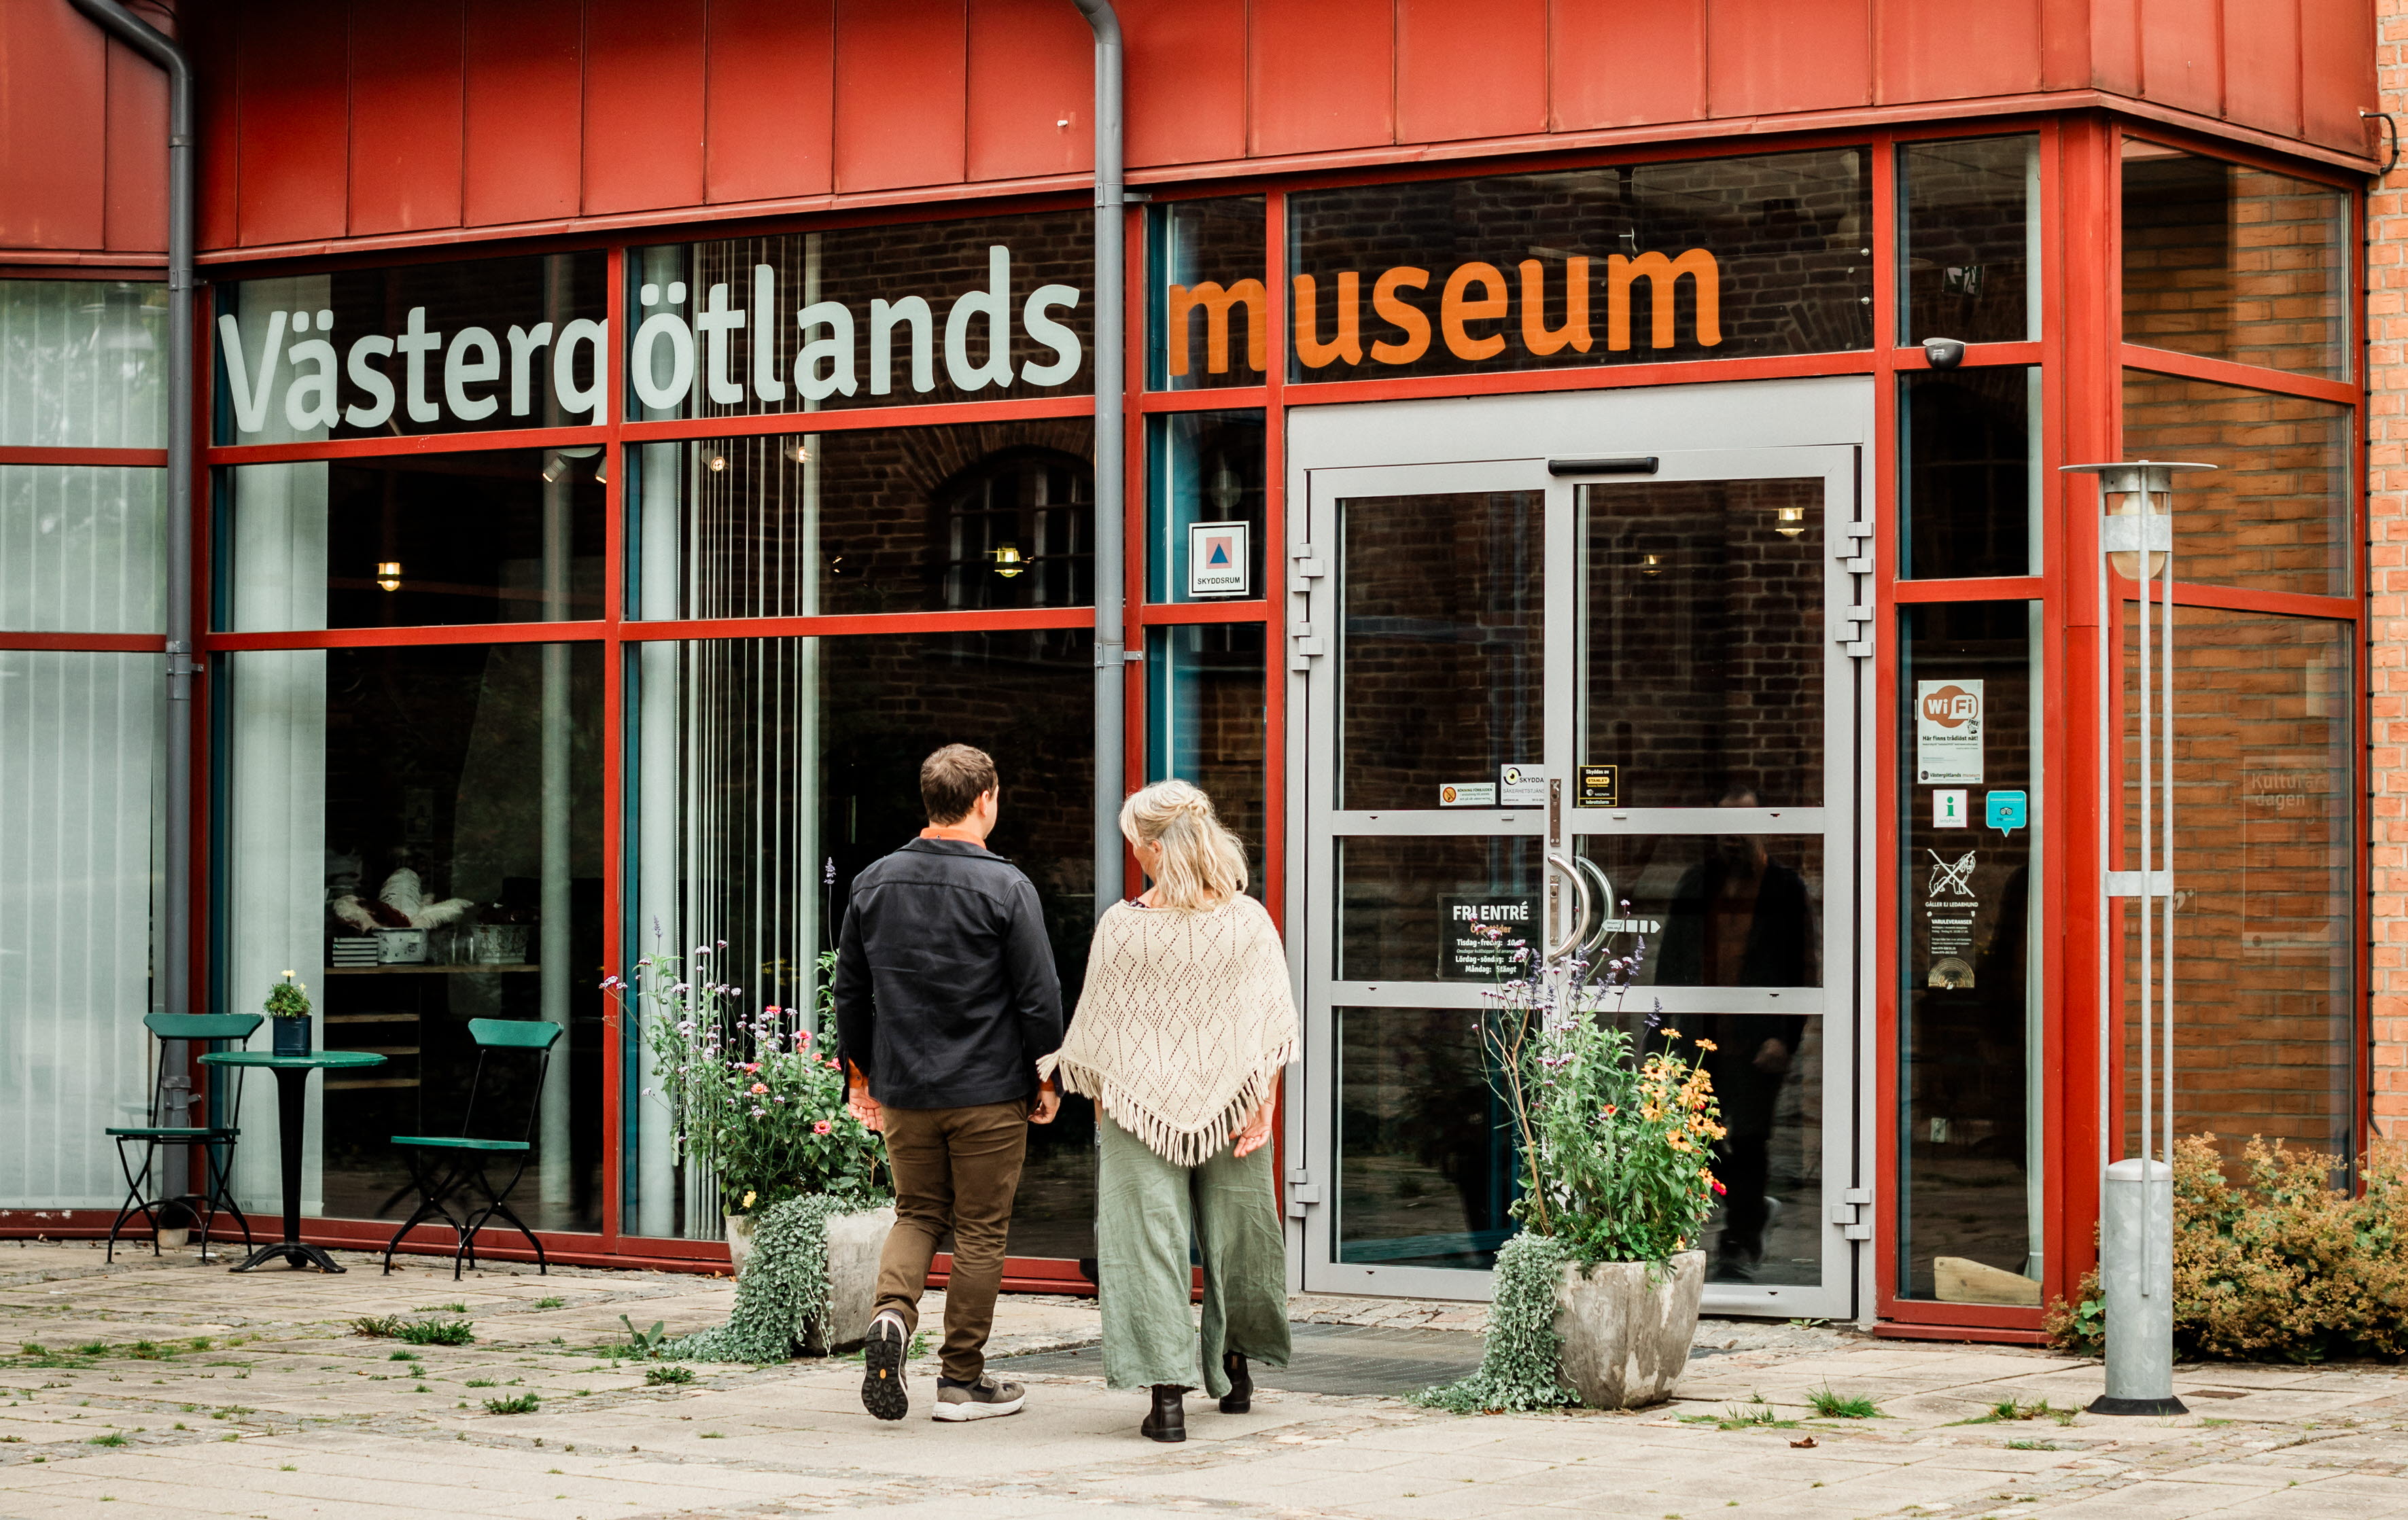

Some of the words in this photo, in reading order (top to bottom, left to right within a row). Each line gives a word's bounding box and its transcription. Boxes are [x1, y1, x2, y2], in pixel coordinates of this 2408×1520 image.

[218, 245, 1082, 457] Västergötlands
[1168, 247, 1722, 376] museum
[1198, 577, 1240, 585] SKYDDSRUM
[2256, 789, 2305, 811] dagen
[1453, 905, 1477, 921] FRI
[1480, 900, 1529, 921] ENTRÉ
[1465, 964, 1492, 974] Måndag:
[1496, 964, 1517, 974] Stängt
